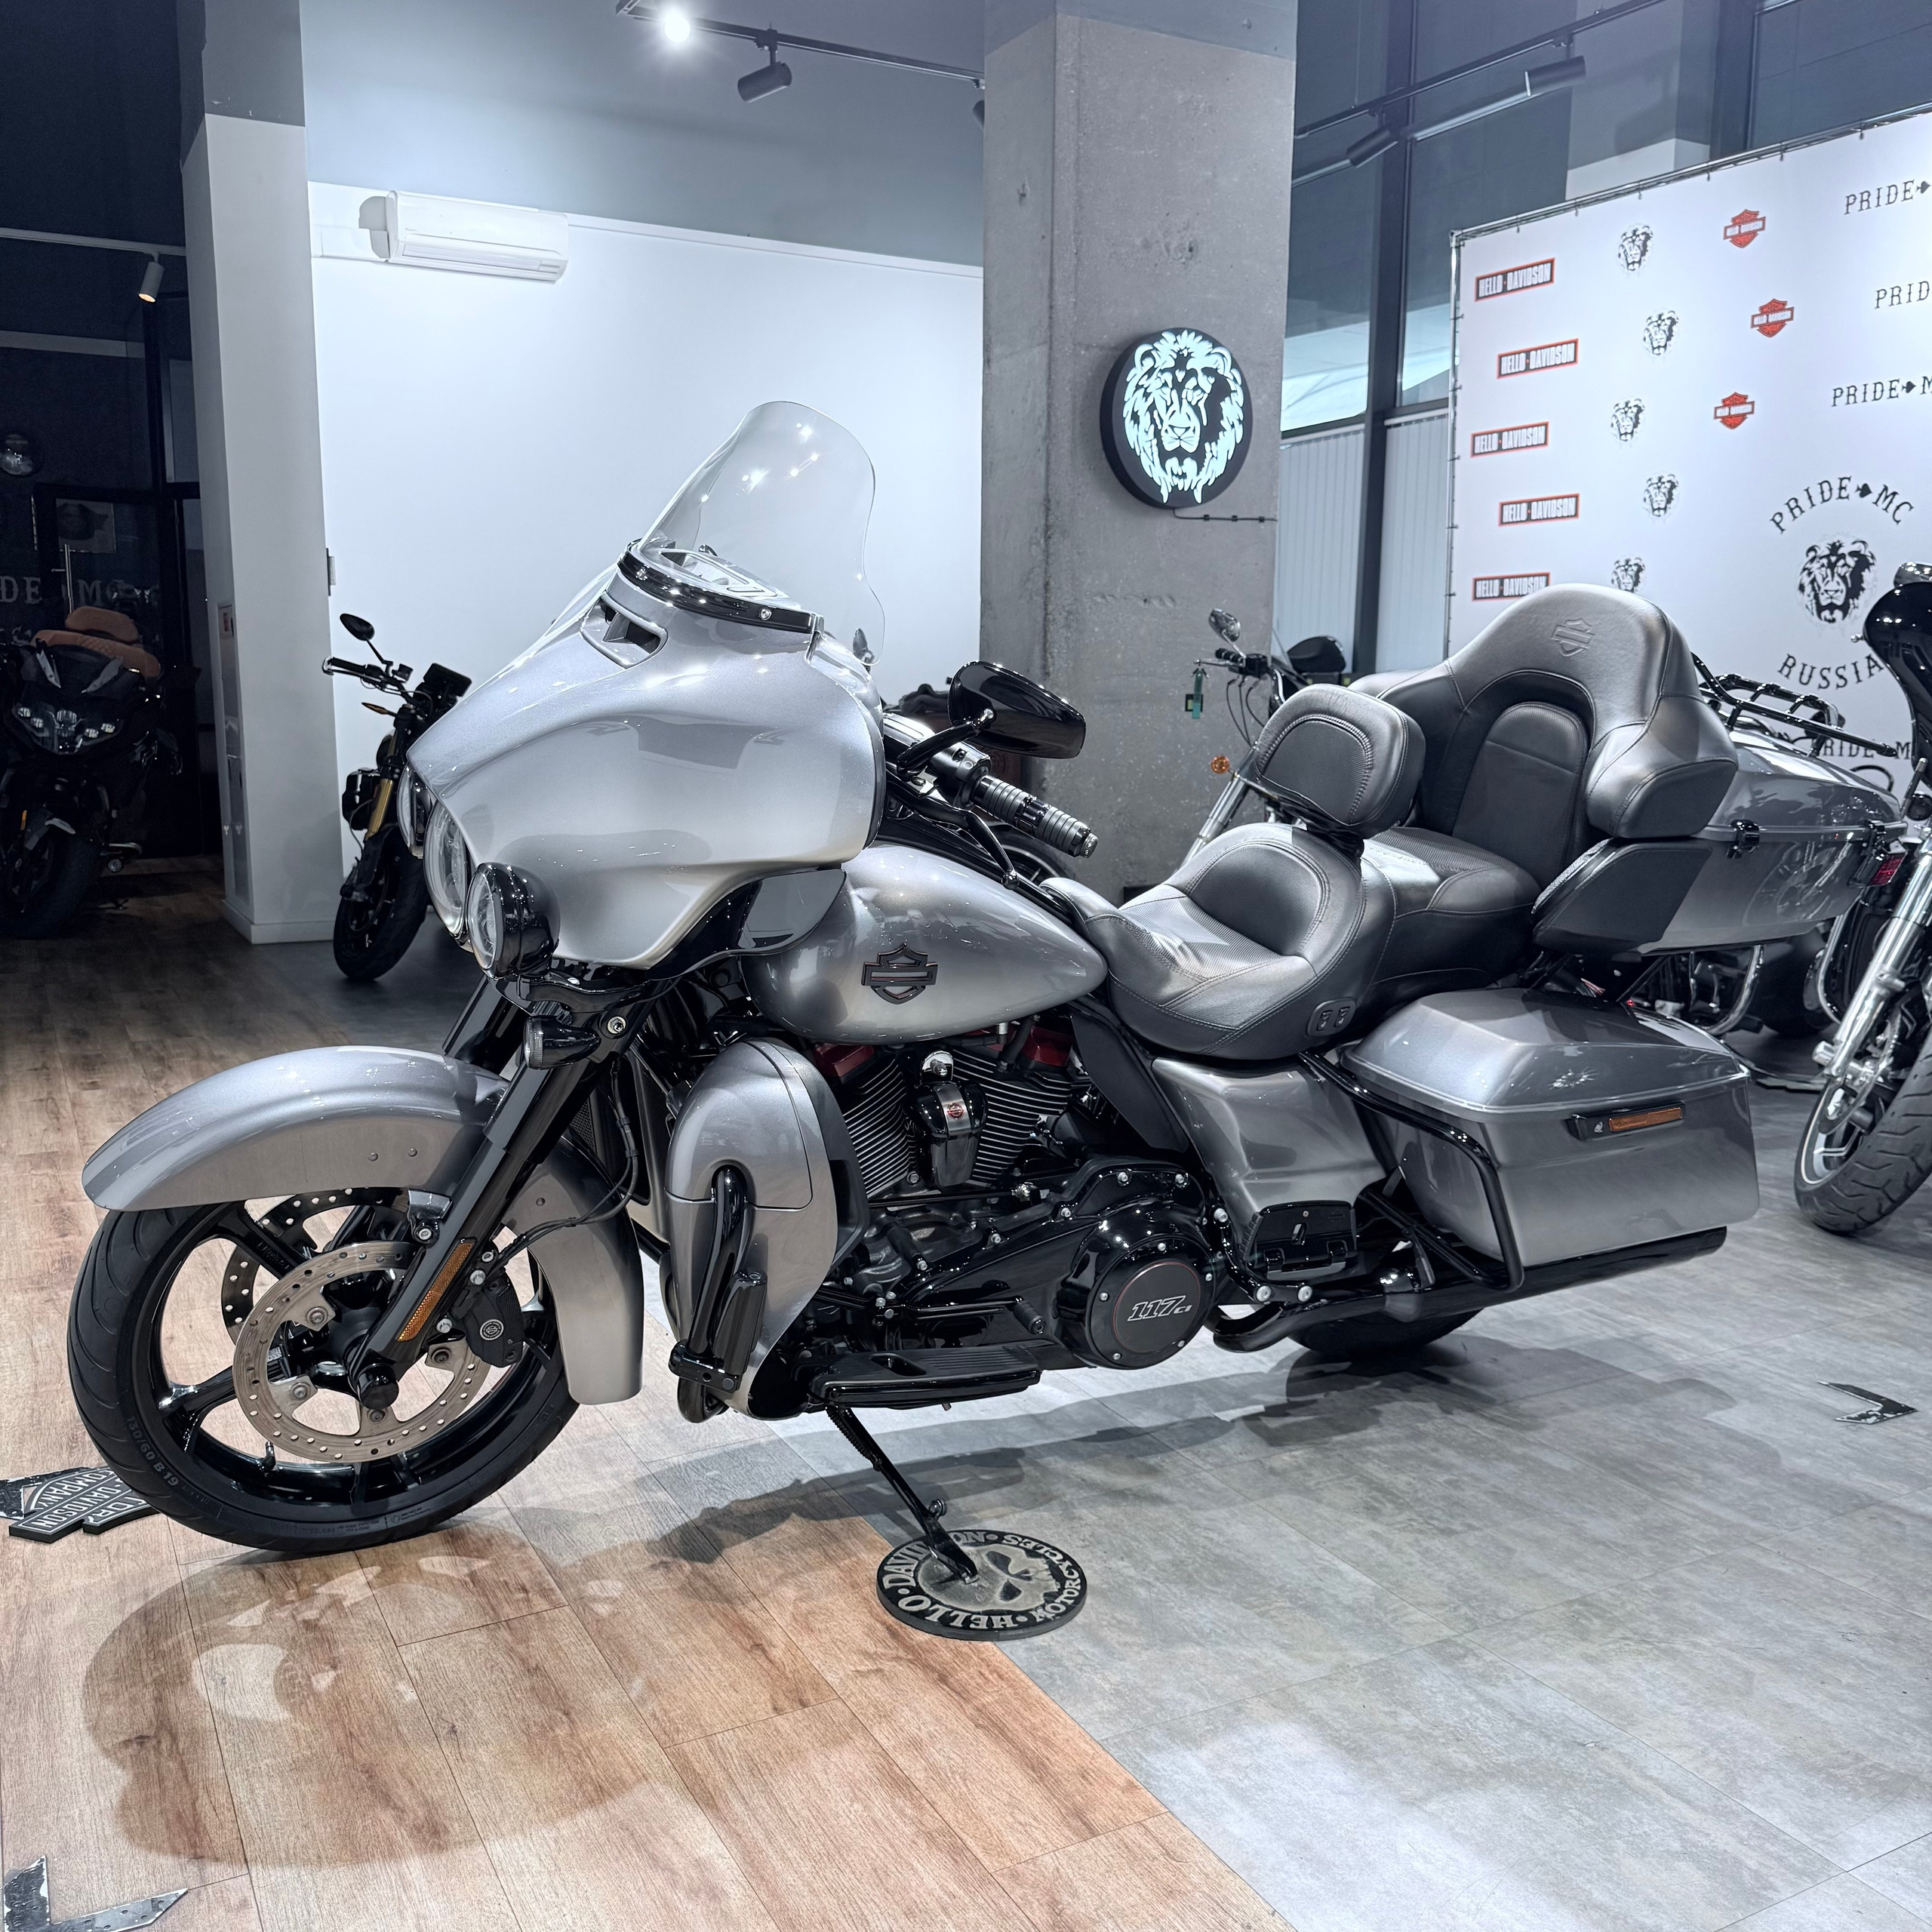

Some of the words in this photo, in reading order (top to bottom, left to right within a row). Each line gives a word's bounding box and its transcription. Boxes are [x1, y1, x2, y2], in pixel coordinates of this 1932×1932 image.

[1844, 179, 1915, 215] PRIDE
[1478, 275, 1503, 297] HELLO
[1507, 263, 1552, 291] DAVIDSON
[1875, 281, 1930, 309] PRID
[1501, 352, 1526, 374] HELLO
[1529, 342, 1575, 369] DAVIDSON
[1832, 379, 1900, 407] PRIDE
[1475, 433, 1498, 454] HELLO
[1502, 425, 1546, 449] DAVIDSON
[1503, 503, 1527, 522] HELLO
[1531, 497, 1577, 520] DAVIDSON
[1770, 475, 1852, 534] PRIDE
[1872, 484, 1914, 525] MC
[1476, 579, 1500, 598] HELLO
[1503, 576, 1547, 596] DAVIDSON
[1777, 654, 1884, 690] RUSSIA
[1823, 738, 1874, 758] RIDE
[127, 1416, 155, 1460] 130/60
[153, 1462, 165, 1472] B
[163, 1472, 179, 1486] 19
[31, 1487, 122, 1527] DAVIDSON
[92, 1497, 146, 1517] TOR
[898, 1595, 1019, 1629] HELLO
[1002, 1534, 1081, 1622] MOTORCYCLES
